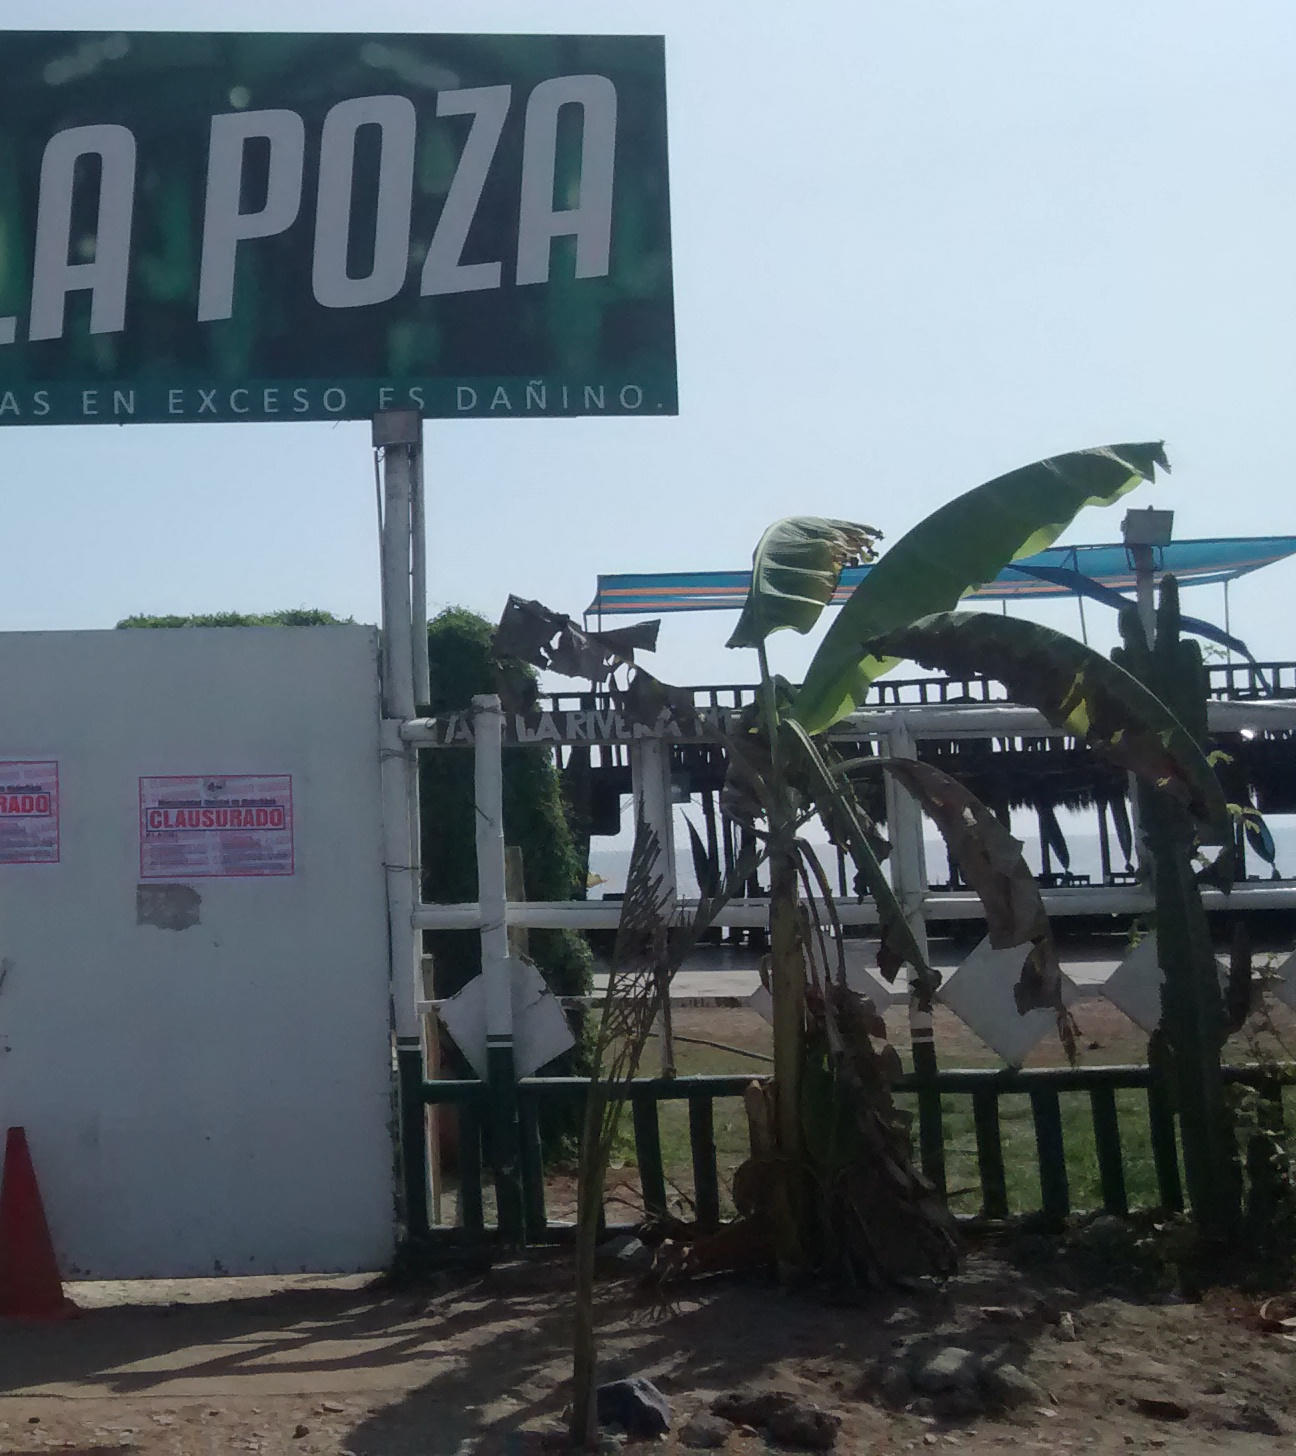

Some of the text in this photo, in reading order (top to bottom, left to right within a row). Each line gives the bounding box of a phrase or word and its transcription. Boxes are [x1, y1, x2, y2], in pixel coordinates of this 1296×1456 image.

[197, 73, 618, 322] POZA
[82, 390, 135, 415] EN
[168, 387, 347, 414] EXCESO
[149, 808, 283, 829] CLAUSURADO
